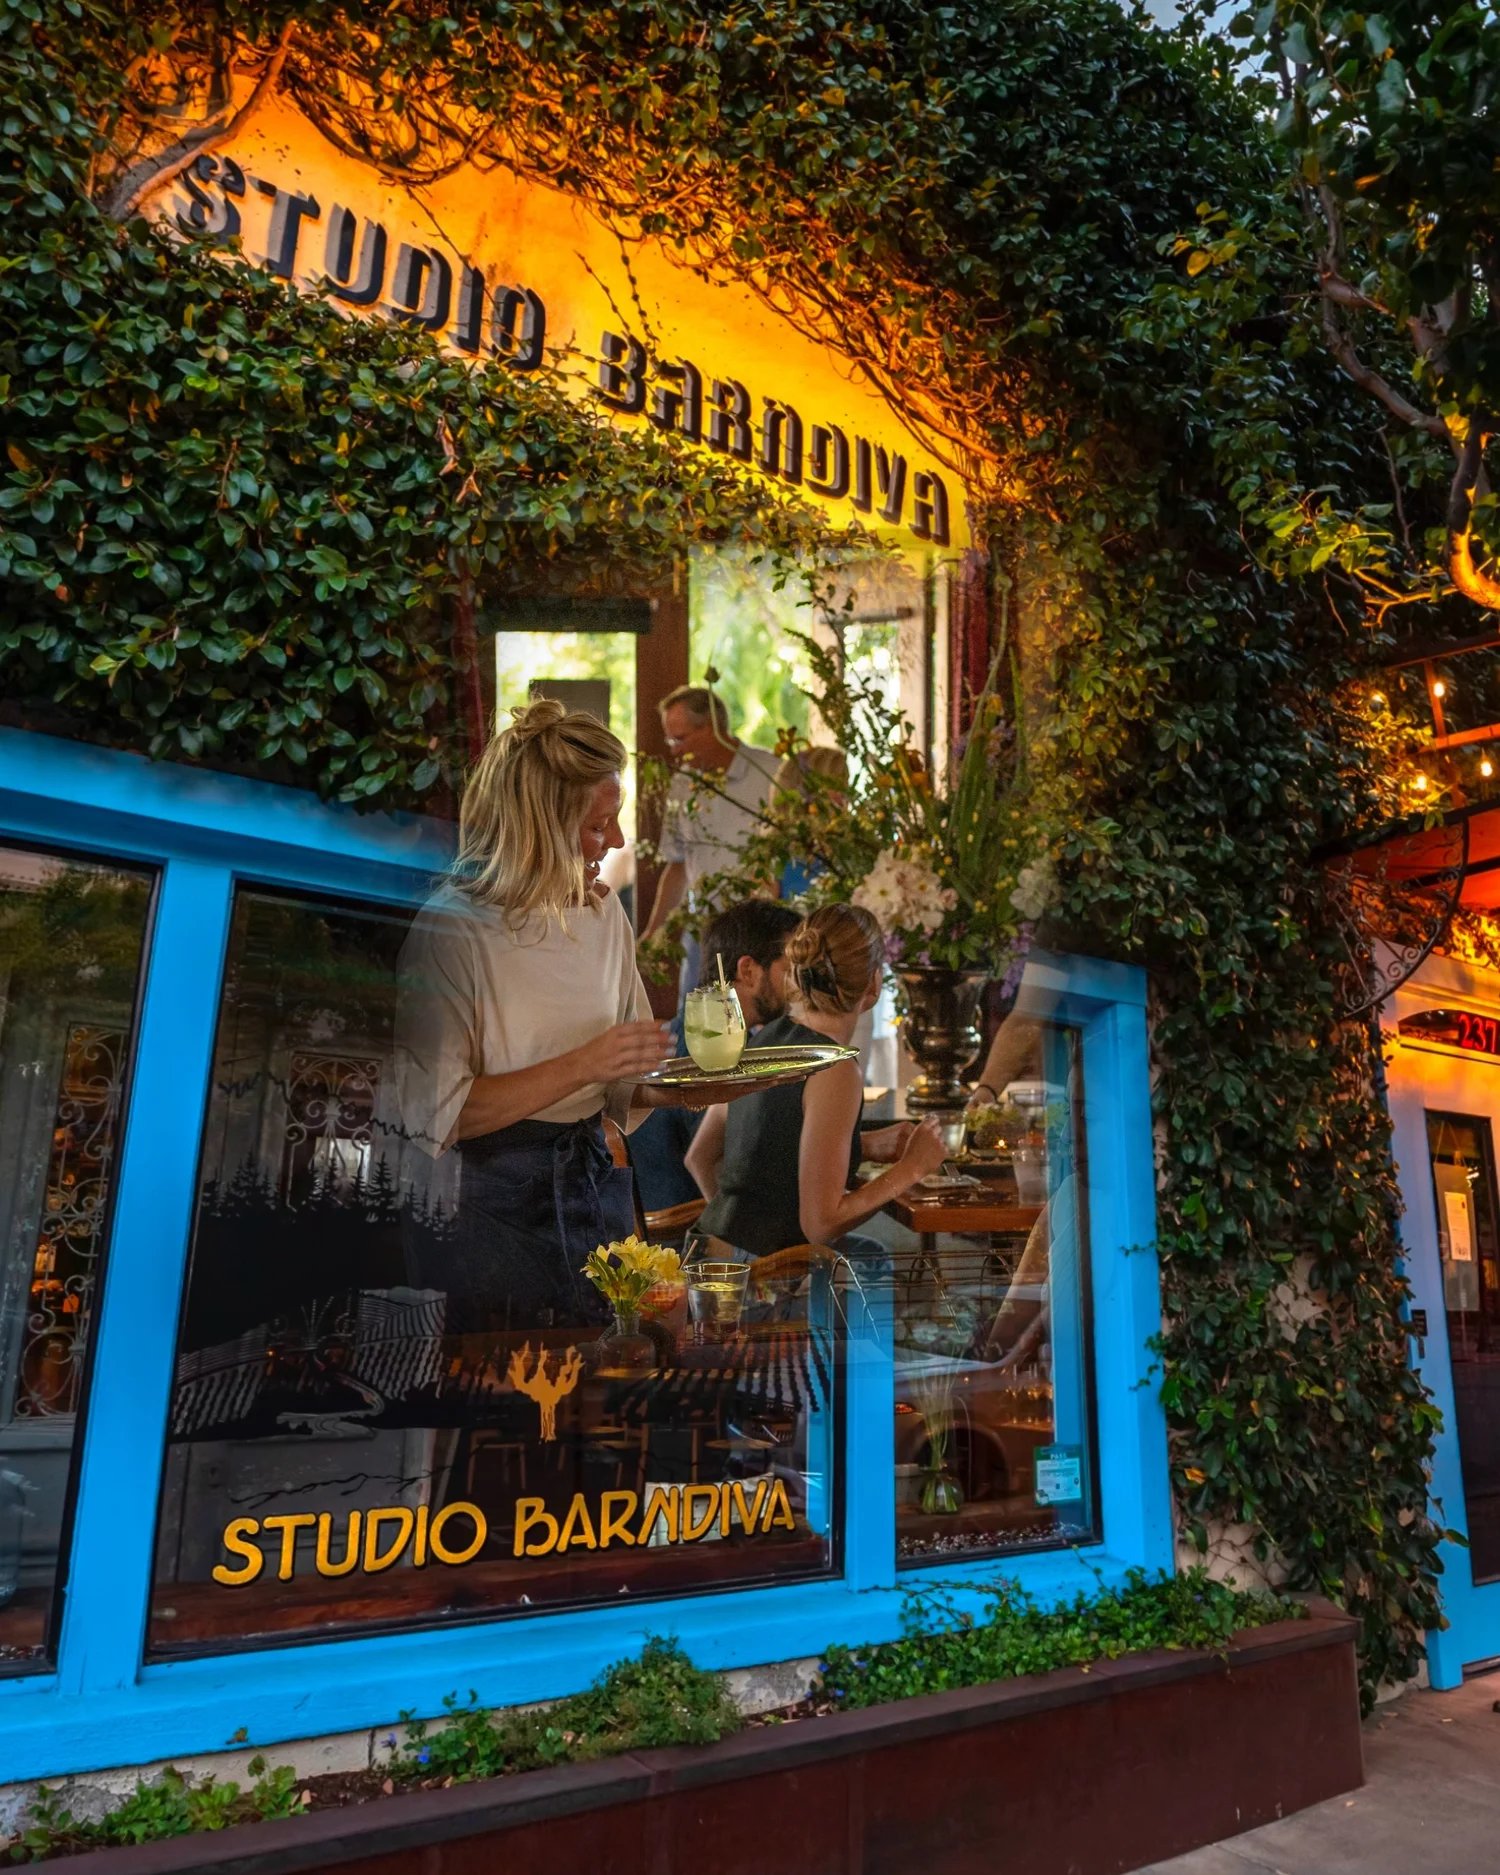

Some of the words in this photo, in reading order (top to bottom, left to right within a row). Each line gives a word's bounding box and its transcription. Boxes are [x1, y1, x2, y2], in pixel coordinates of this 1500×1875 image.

[174, 153, 547, 371] STUDIO
[1458, 1013, 1497, 1054] 237
[211, 1500, 488, 1587] STUDIO
[513, 1478, 796, 1558] BARNDIVA
